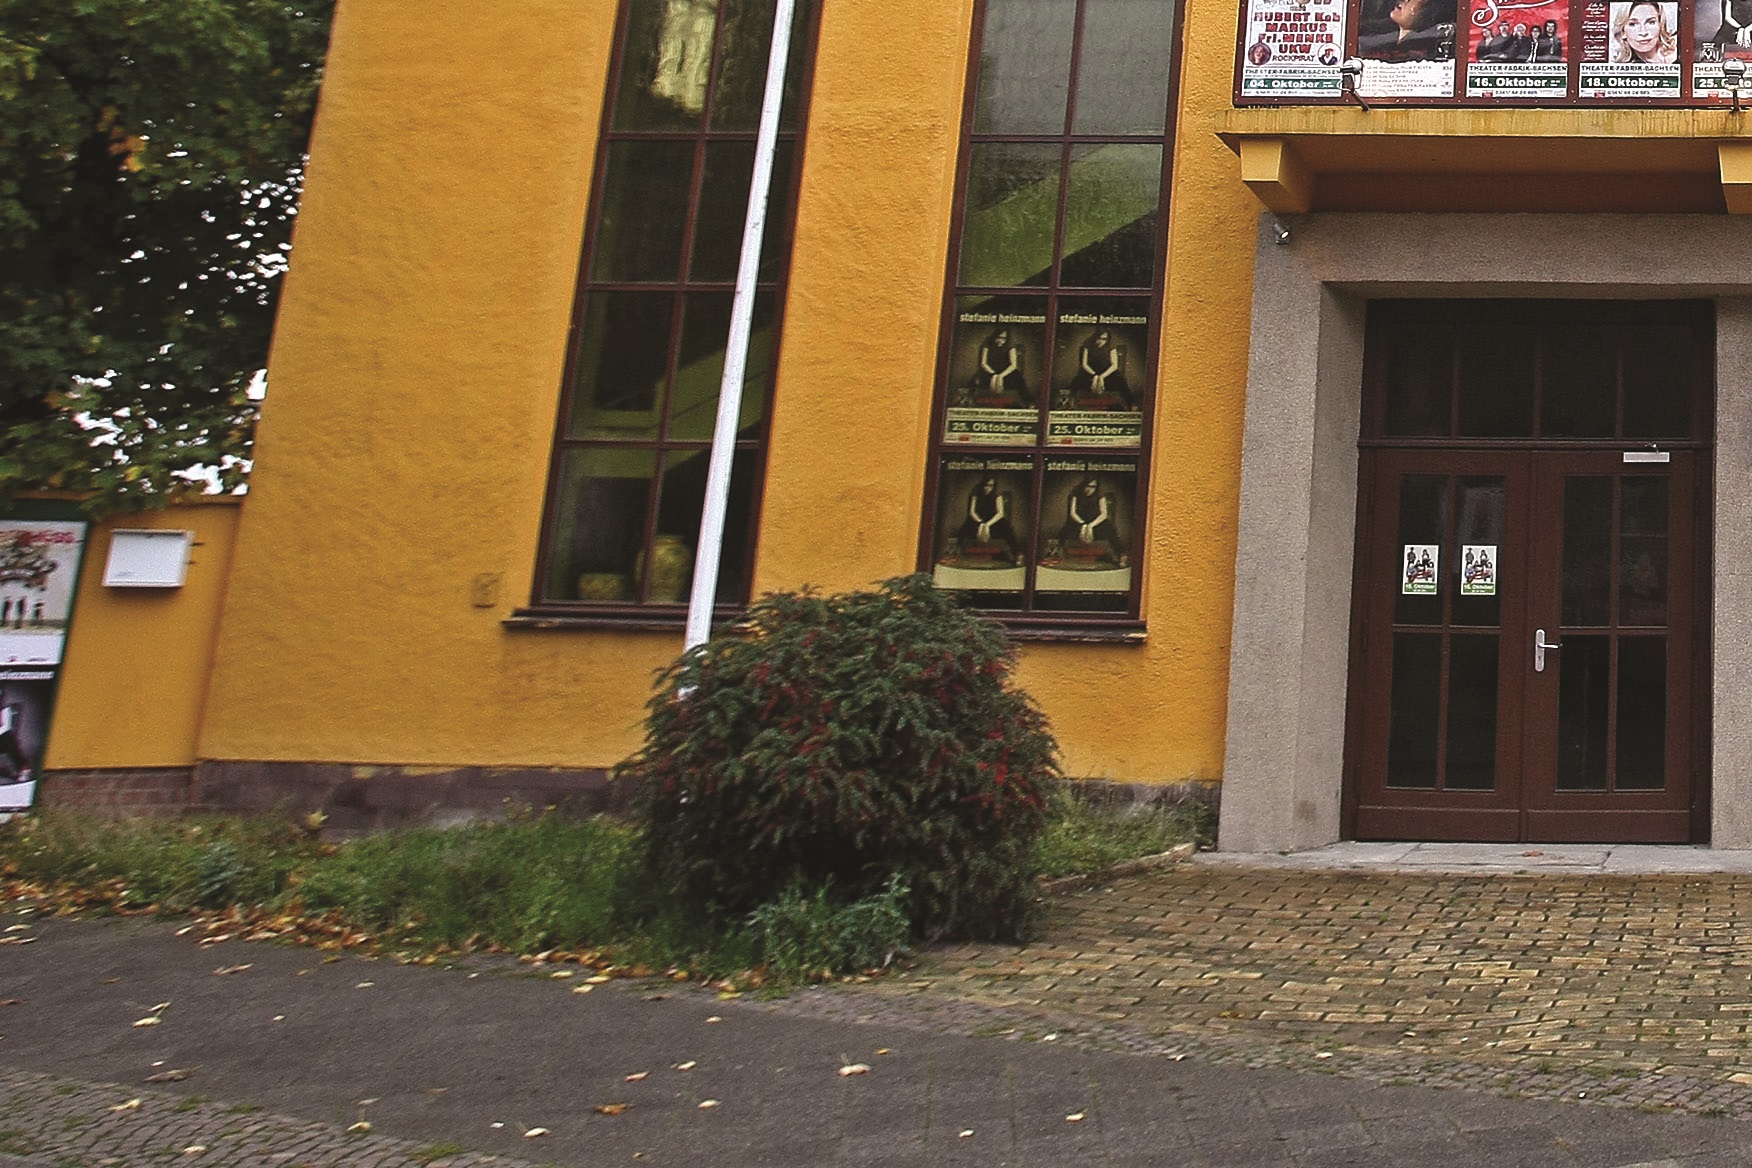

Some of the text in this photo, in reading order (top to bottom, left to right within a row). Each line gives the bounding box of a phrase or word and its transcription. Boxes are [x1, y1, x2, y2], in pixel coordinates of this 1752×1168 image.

[1265, 22, 1328, 32] MARKUS
[1278, 43, 1312, 54] UKW
[1249, 79, 1269, 88] 04.
[1271, 79, 1320, 88] Oktober
[1474, 77, 1493, 87] 16.
[1495, 77, 1548, 87] Oktober
[1586, 77, 1605, 87] 18.
[1608, 77, 1659, 87] Oktober
[1699, 78, 1718, 88] 25.
[959, 313, 1046, 324] stefanie heinzmann
[1059, 313, 1147, 325] stefanie heinzmann
[952, 422, 1020, 433] 25. Oktober
[1054, 425, 1124, 435] 25. Oktober
[947, 460, 1034, 471] stefanie heinzmann
[1047, 461, 1136, 472] stefanie heinzmann
